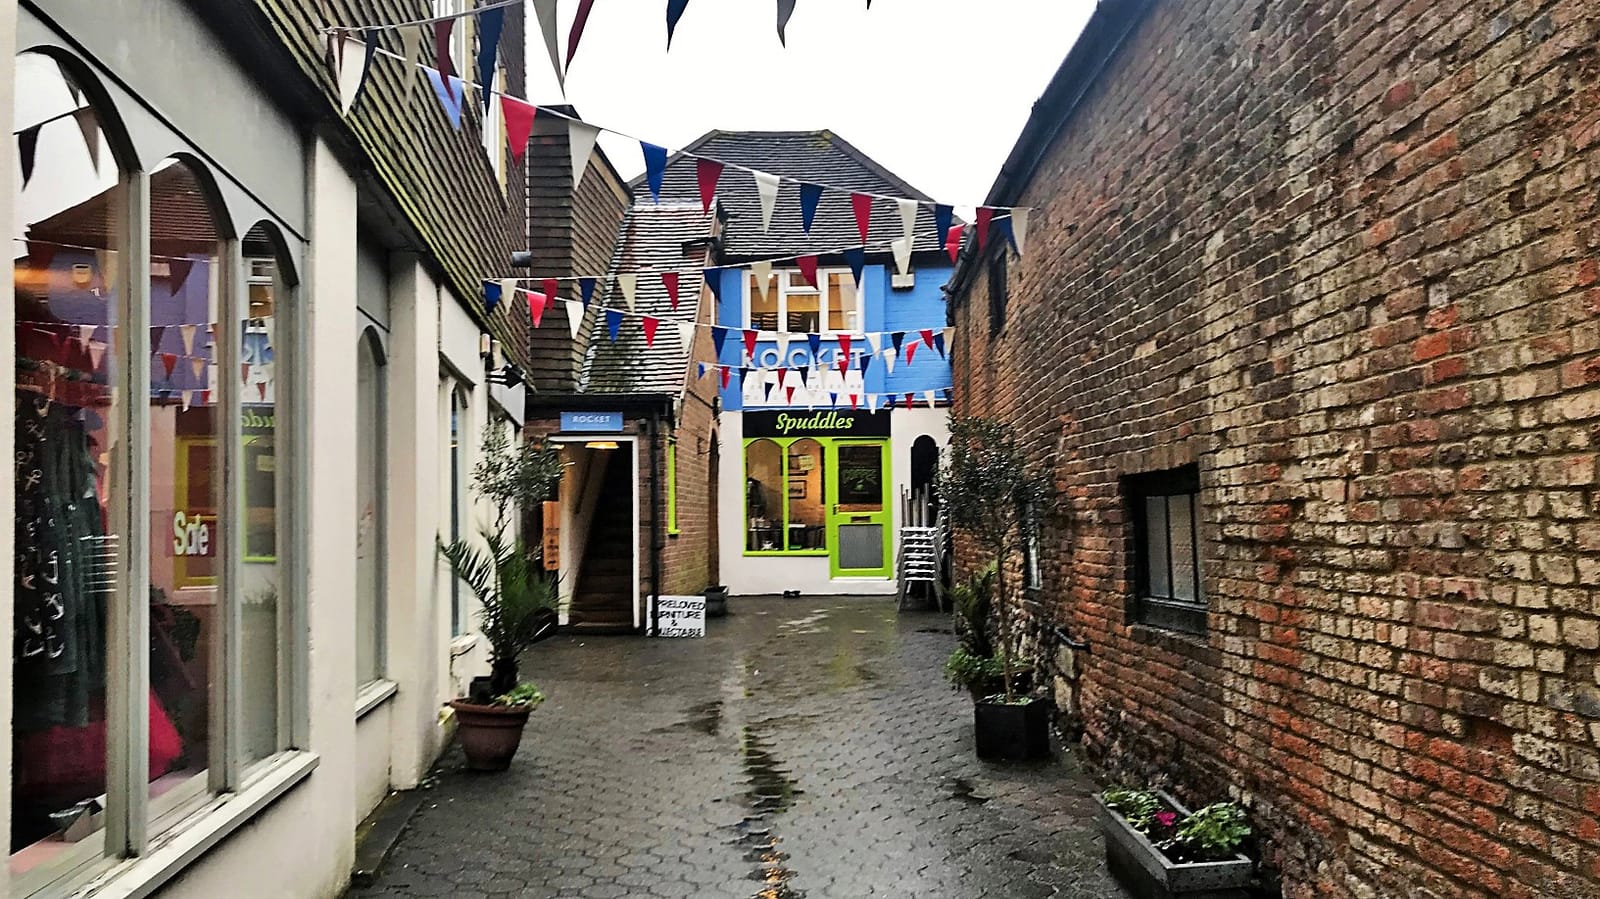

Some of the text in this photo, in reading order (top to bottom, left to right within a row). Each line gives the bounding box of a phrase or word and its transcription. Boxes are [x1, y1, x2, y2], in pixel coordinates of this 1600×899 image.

[741, 347, 865, 369] ROCKET
[572, 415, 611, 424] ROCKET
[775, 412, 854, 434] Spuddles
[173, 510, 209, 555] Sale
